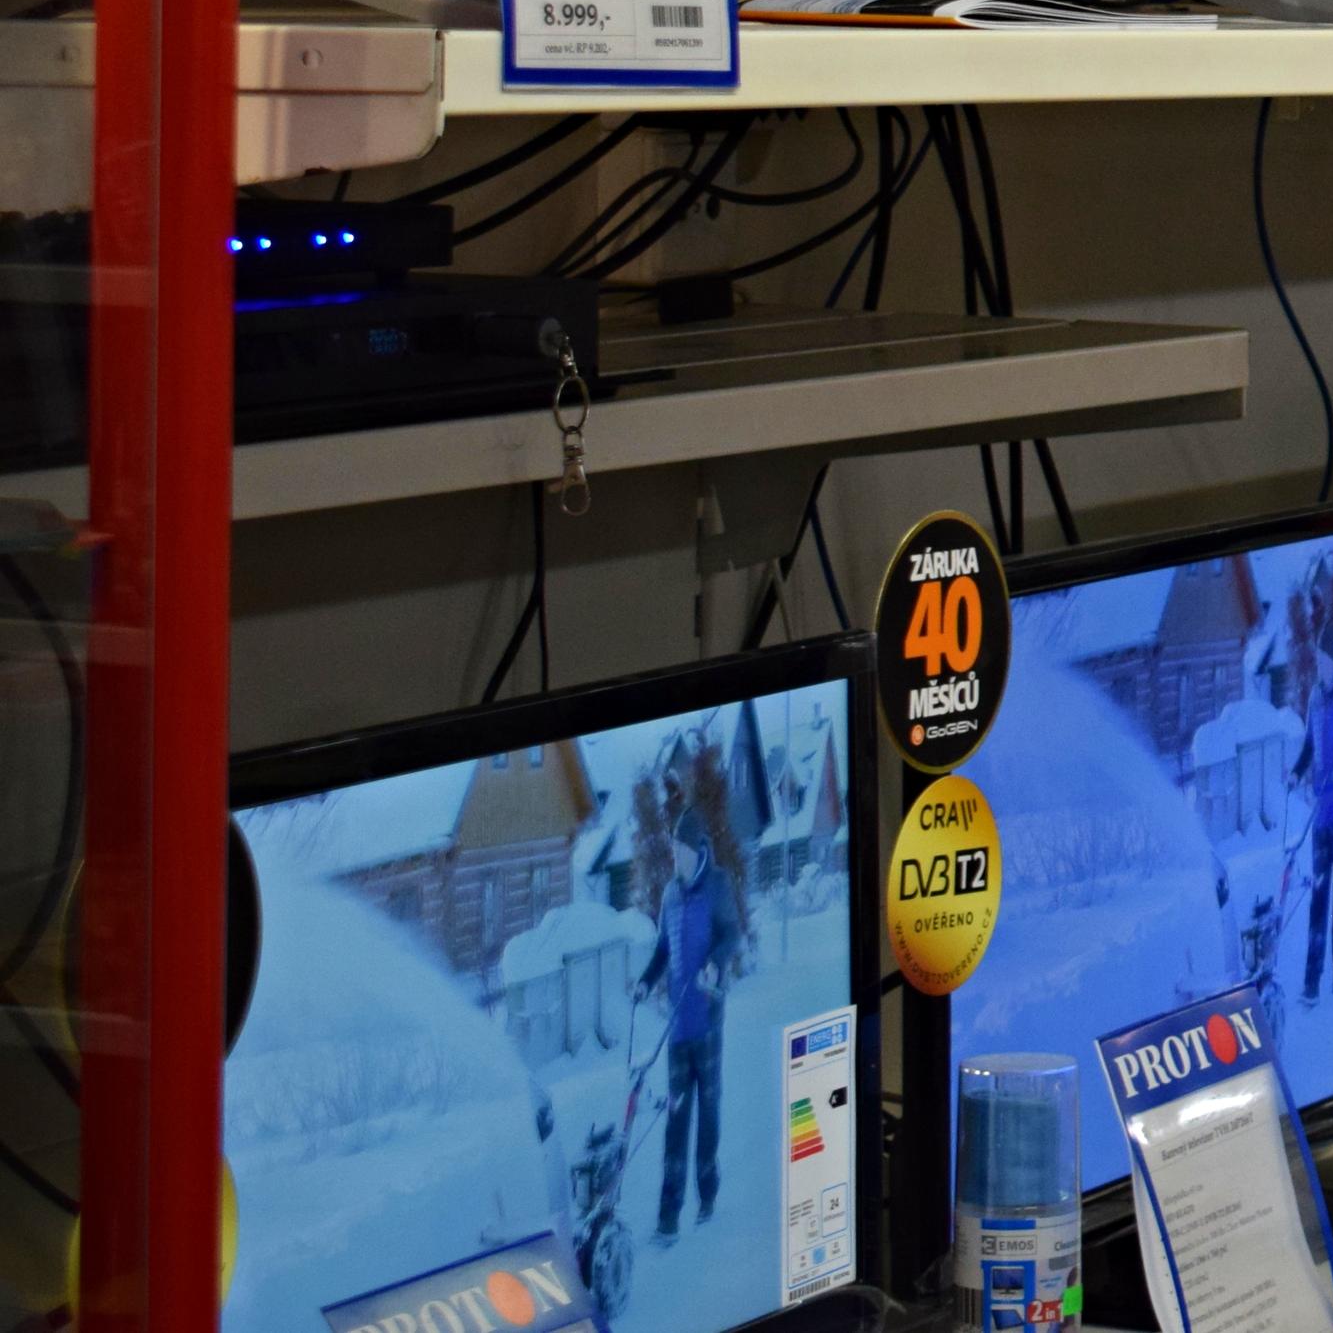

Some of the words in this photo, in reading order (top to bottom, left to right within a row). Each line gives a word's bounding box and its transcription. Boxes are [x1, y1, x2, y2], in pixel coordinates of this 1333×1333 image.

[543, 2, 611, 31] 8.999,-
[910, 547, 979, 582] ZÁRUKA
[904, 575, 983, 677] 40
[909, 671, 980, 720] MĚSÍCŮ
[926, 719, 978, 739] GoGEN
[919, 802, 959, 831] CRA
[900, 854, 949, 901] DVB
[957, 850, 986, 891] T2
[914, 910, 974, 934] OVĚŘENO
[1113, 1007, 1262, 1099] PROTON
[999, 1240, 1034, 1252] EMOS
[1031, 1300, 1043, 1322] 2
